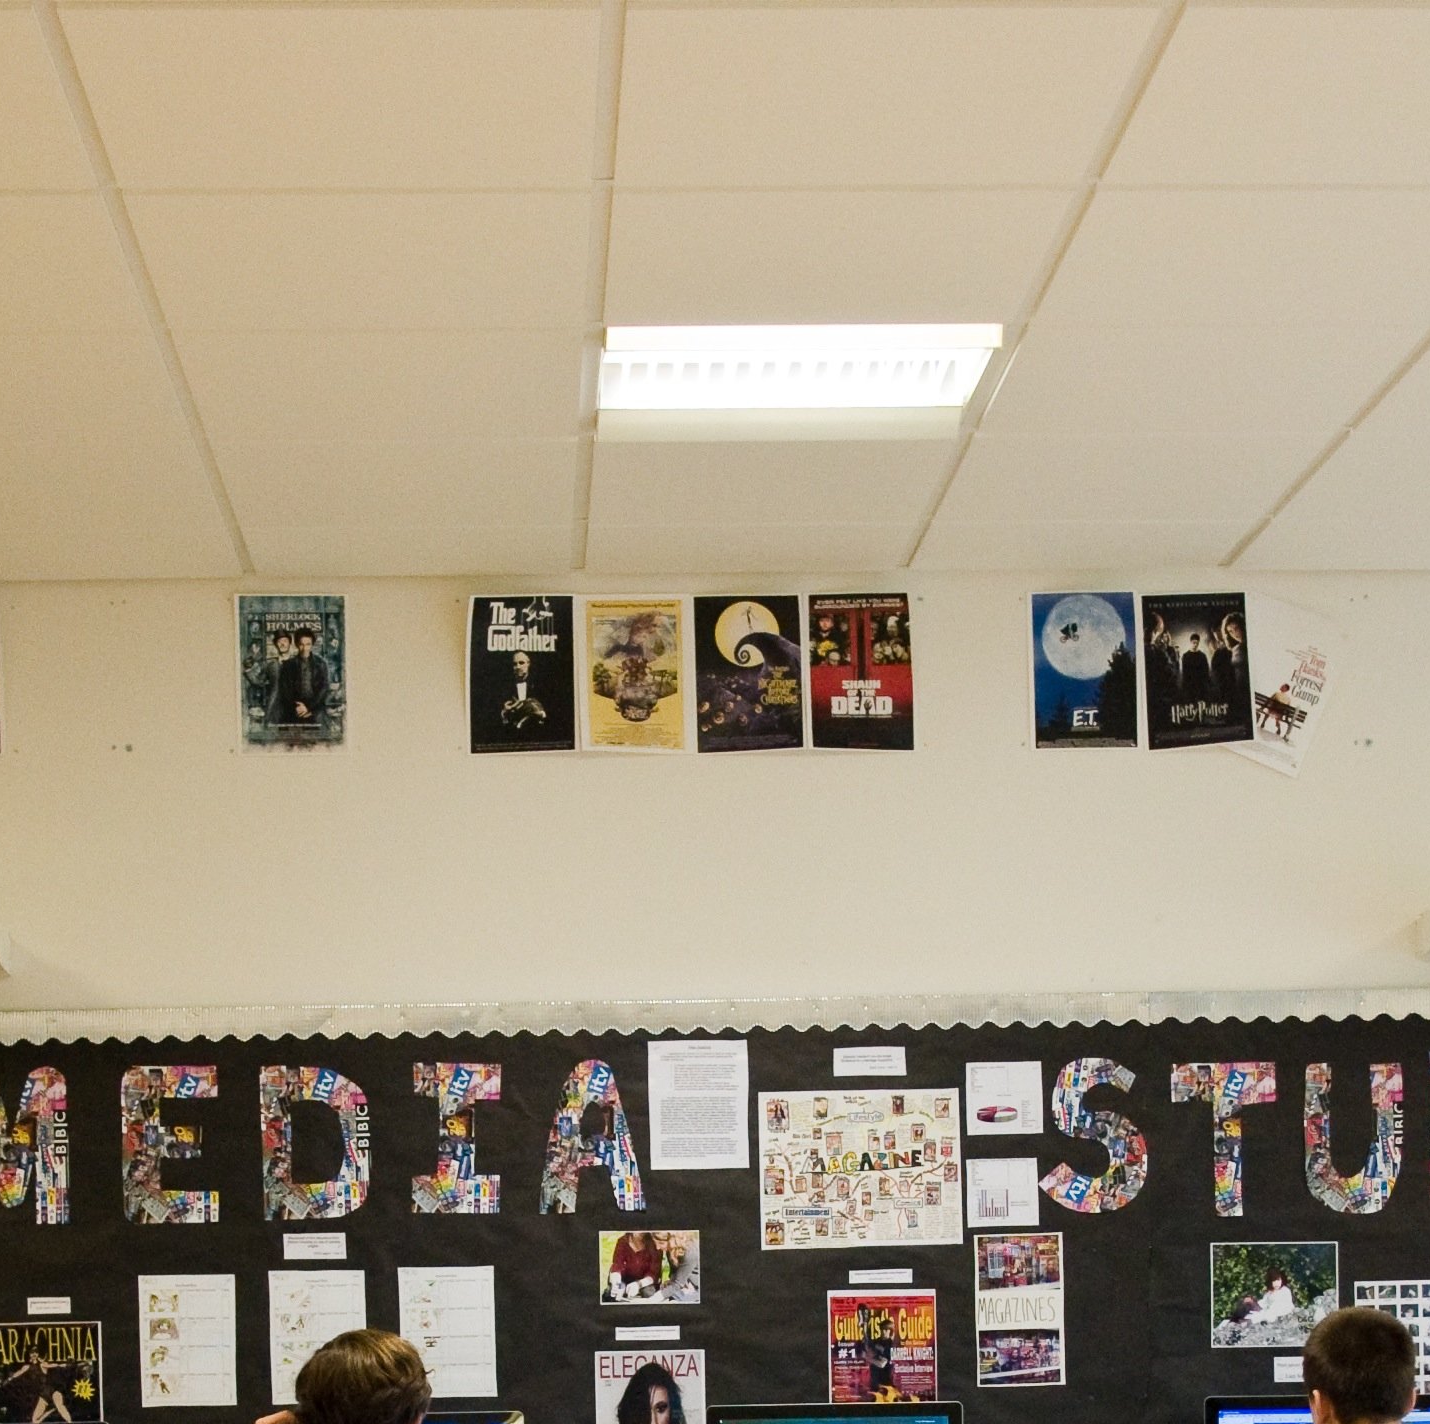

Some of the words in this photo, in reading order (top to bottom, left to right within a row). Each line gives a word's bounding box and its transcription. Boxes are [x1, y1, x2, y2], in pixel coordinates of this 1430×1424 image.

[266, 613, 321, 621] SHERLOCK
[266, 622, 322, 631] HOLMES
[490, 602, 516, 625] The
[487, 625, 558, 652] Godfather
[842, 680, 881, 690] SHAUN
[831, 696, 893, 715] DEAD
[1073, 709, 1098, 727] E.T.
[1171, 705, 1197, 724] Harry
[1198, 701, 1229, 717] Potter
[451, 1068, 471, 1097] itv
[589, 1067, 609, 1093] itv
[1225, 1071, 1244, 1098] itv
[54, 1111, 69, 1155] BBC
[357, 1104, 371, 1148] BBC
[801, 1150, 922, 1176] MAGAZINE
[1069, 1176, 1091, 1202] itv
[785, 1208, 830, 1216] Entertainment
[898, 1307, 933, 1340] Guide
[977, 1297, 1056, 1325] MAGAZINES
[838, 1348, 856, 1359] #1
